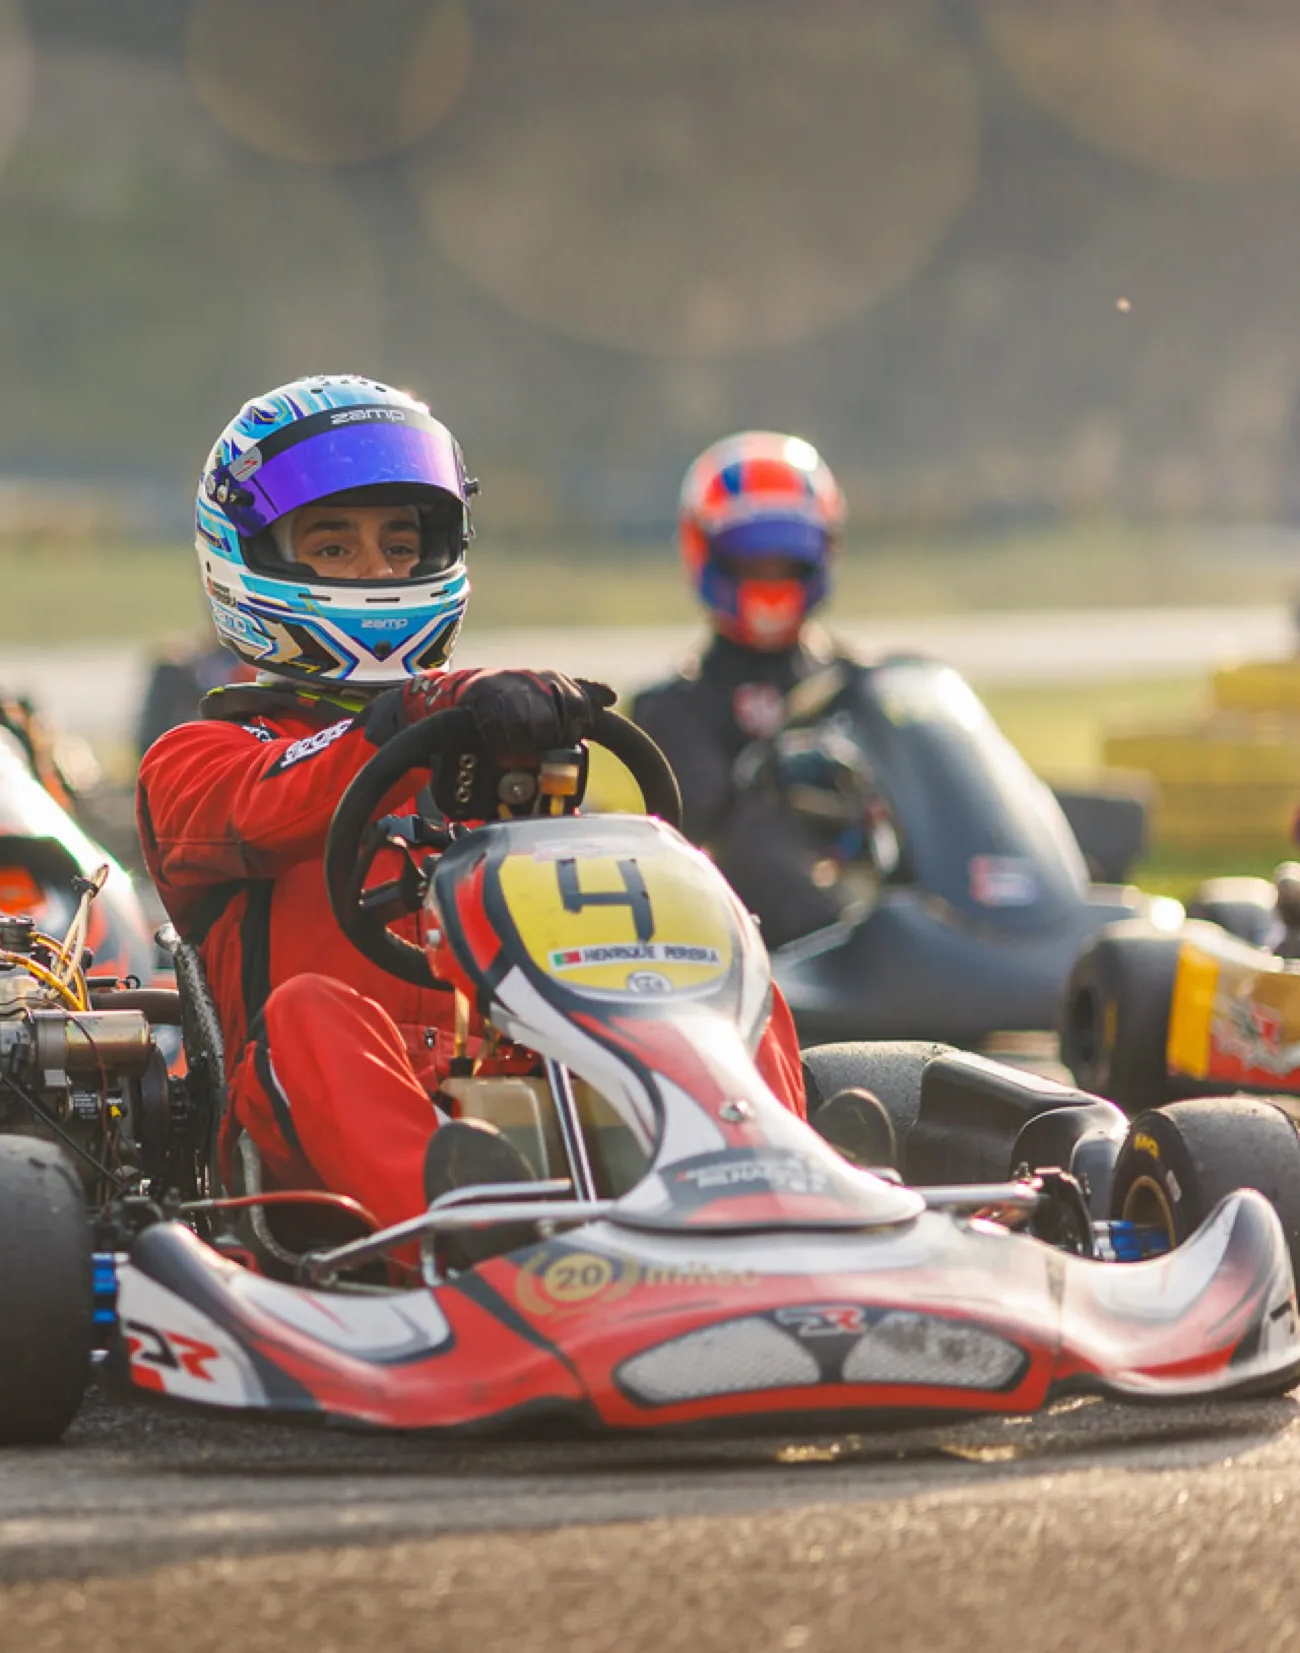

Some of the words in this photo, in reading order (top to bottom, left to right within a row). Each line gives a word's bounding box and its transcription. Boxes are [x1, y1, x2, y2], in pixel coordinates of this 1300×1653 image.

[330, 409, 405, 425] zamp
[361, 618, 408, 630] zamp
[555, 856, 655, 943] 4
[556, 1263, 602, 1291] 20
